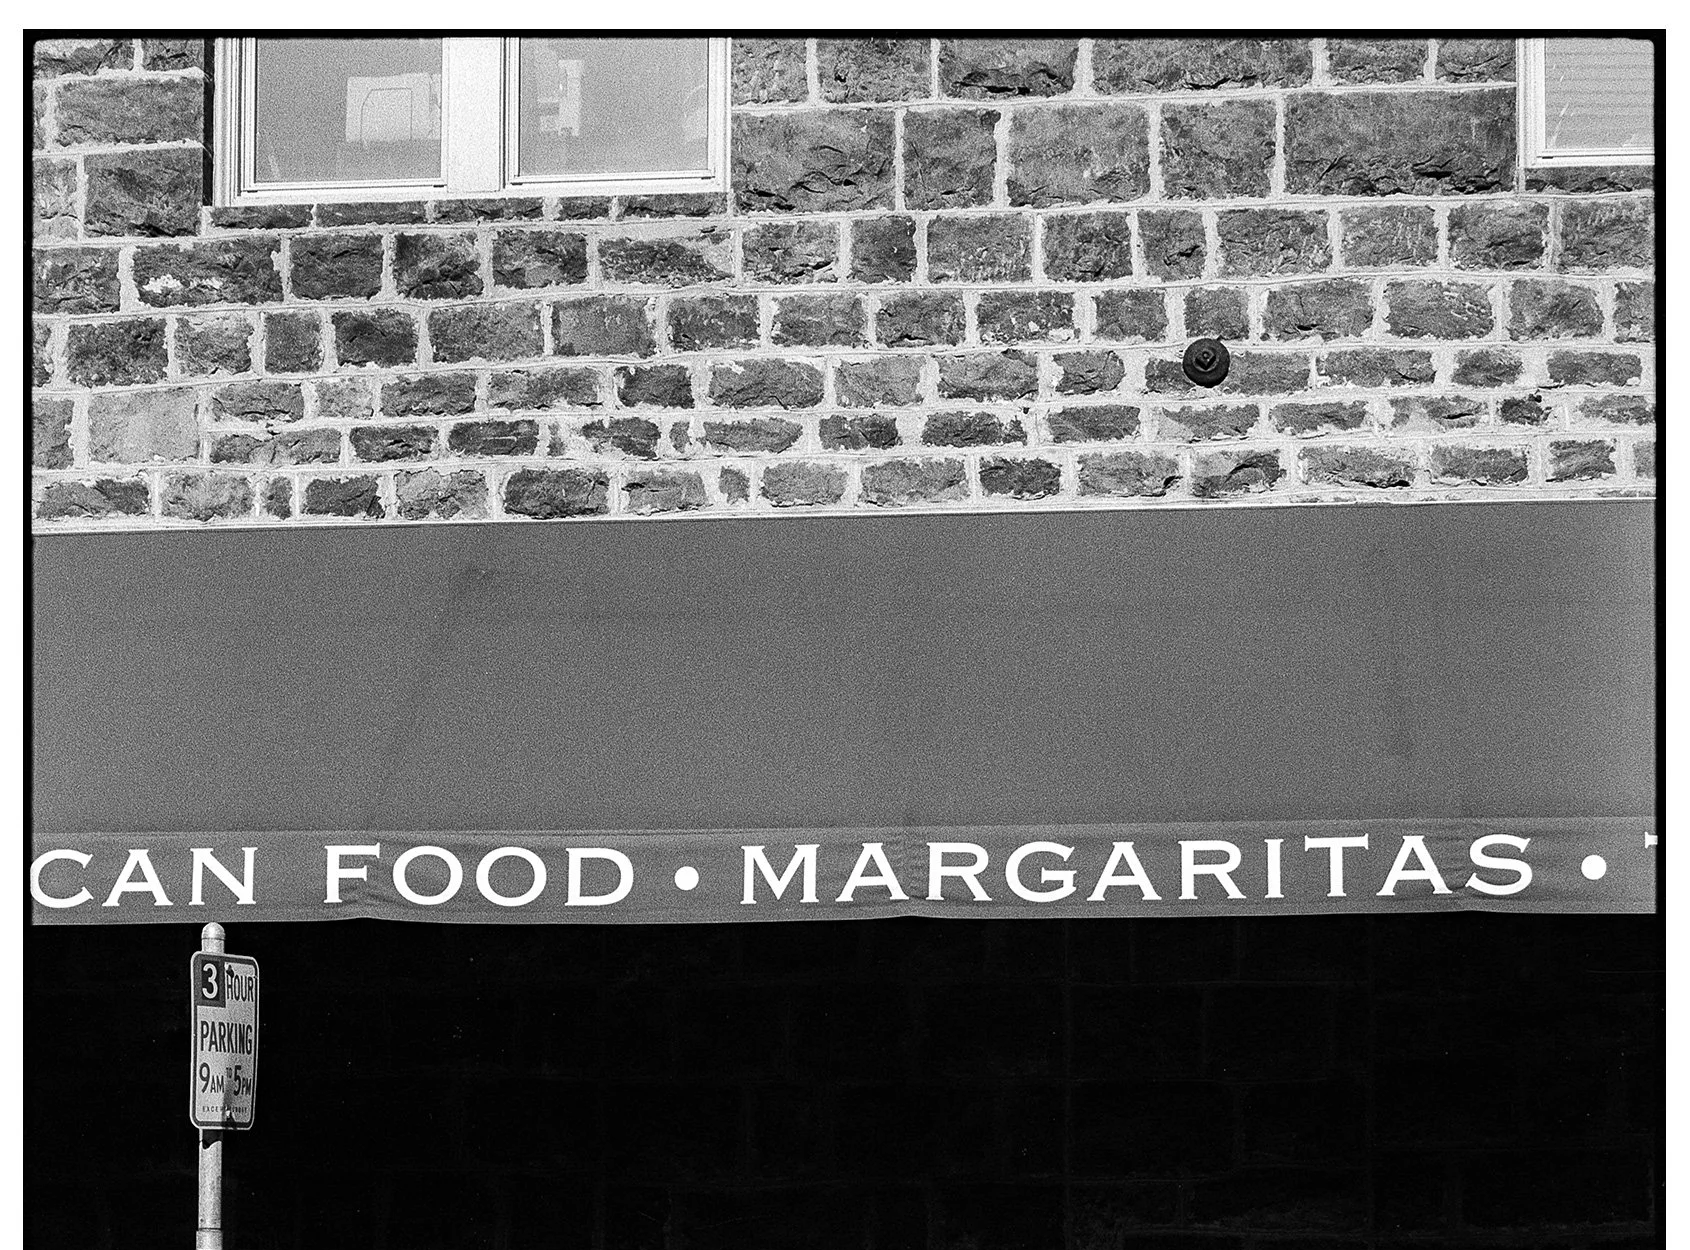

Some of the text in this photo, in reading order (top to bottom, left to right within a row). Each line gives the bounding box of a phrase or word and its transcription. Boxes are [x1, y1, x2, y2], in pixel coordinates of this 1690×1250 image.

[30, 833, 1534, 908] CAN FOOD MARGARITAS
[202, 963, 254, 1003] 3 HOUR
[200, 1020, 253, 1056] PARKING
